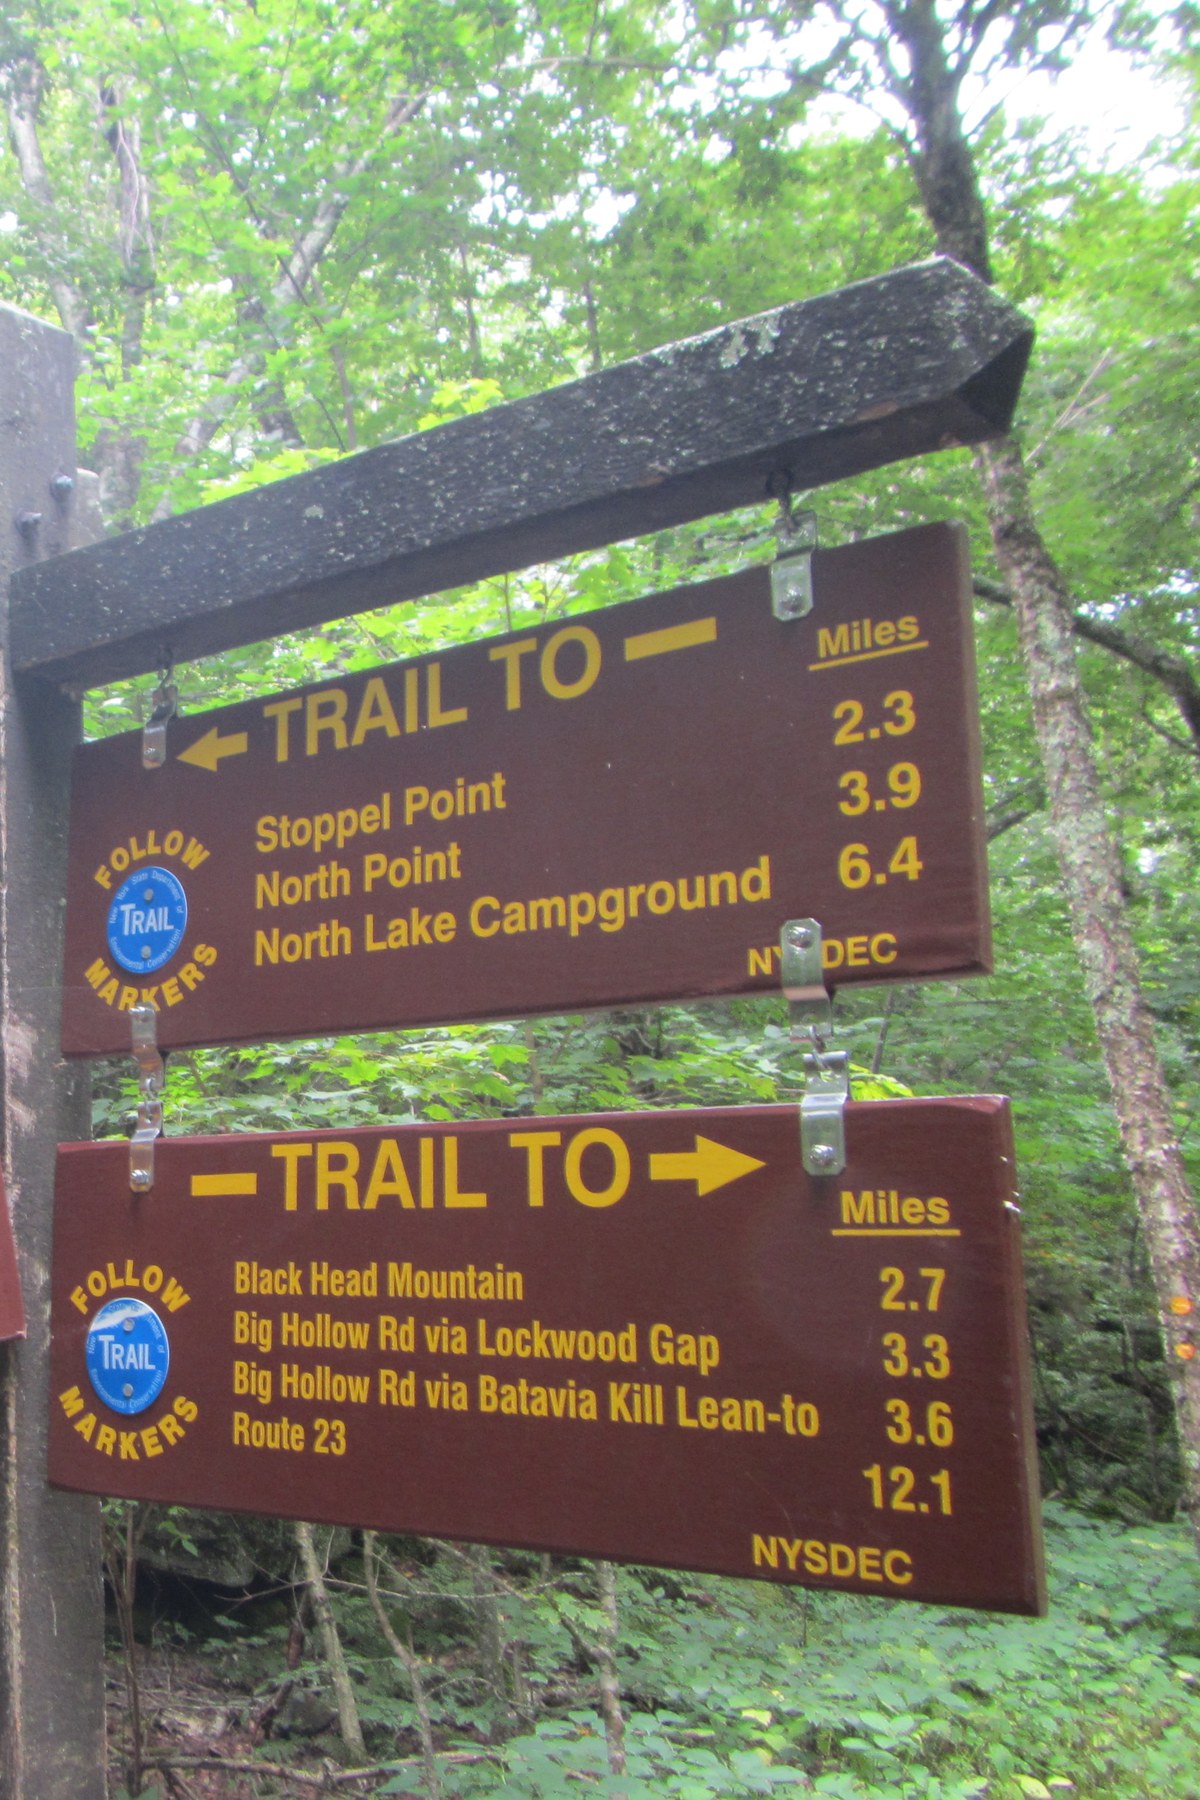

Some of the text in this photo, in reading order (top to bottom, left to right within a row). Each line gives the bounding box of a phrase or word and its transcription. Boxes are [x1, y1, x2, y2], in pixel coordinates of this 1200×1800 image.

[818, 615, 920, 658] Miles
[264, 626, 601, 763] TRAIL TO
[832, 690, 916, 745] 2.3
[256, 772, 507, 853] Stoppel Point
[838, 762, 922, 816] 3.9
[94, 829, 211, 889] FOLLOW
[256, 842, 462, 909] North Point
[838, 836, 923, 889] 6.4
[120, 903, 174, 936] TRAIL
[255, 855, 771, 966] North Lake Campground
[85, 944, 217, 1011] MARKERS
[271, 1127, 631, 1211] TRAIL TO
[840, 1191, 950, 1224] Miles
[70, 1259, 191, 1315] FOLLOW
[234, 1261, 523, 1300] Black Head Mountain
[880, 1267, 946, 1312] 2.7
[98, 1334, 156, 1370] TRAIL
[234, 1311, 720, 1376] Big Hollow Rd via Lockwood Gap
[883, 1332, 951, 1379] 3.3
[59, 1385, 198, 1460] MARKERS
[234, 1361, 820, 1437] Big Hollow Rd via Batavia Kill Lean-to
[886, 1399, 954, 1447] 3.6
[233, 1411, 347, 1455] Route 23
[862, 1463, 953, 1516] 12.1
[752, 1533, 913, 1585] NYSDEC
